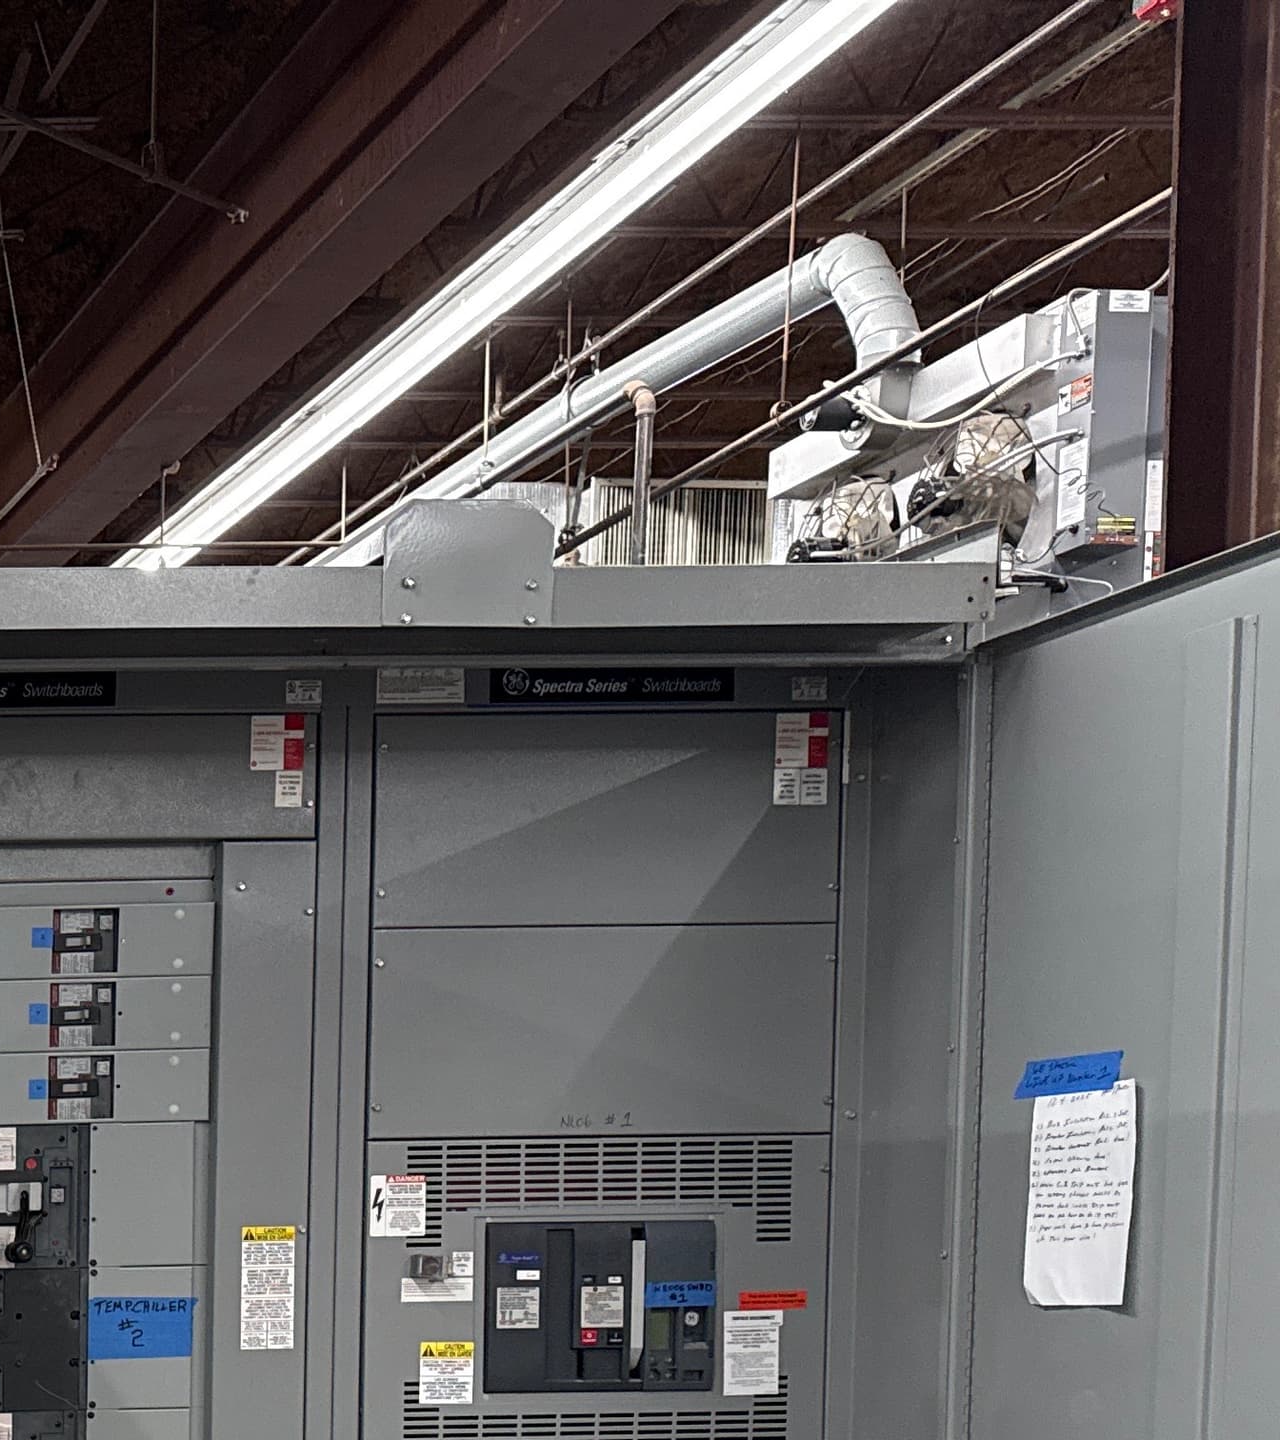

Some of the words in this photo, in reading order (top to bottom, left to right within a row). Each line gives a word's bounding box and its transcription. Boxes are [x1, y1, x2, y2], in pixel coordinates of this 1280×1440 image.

[22, 682, 104, 698] Switchboards
[532, 678, 584, 696] Spectra
[586, 678, 628, 693] Series
[641, 677, 721, 693] Switchboards
